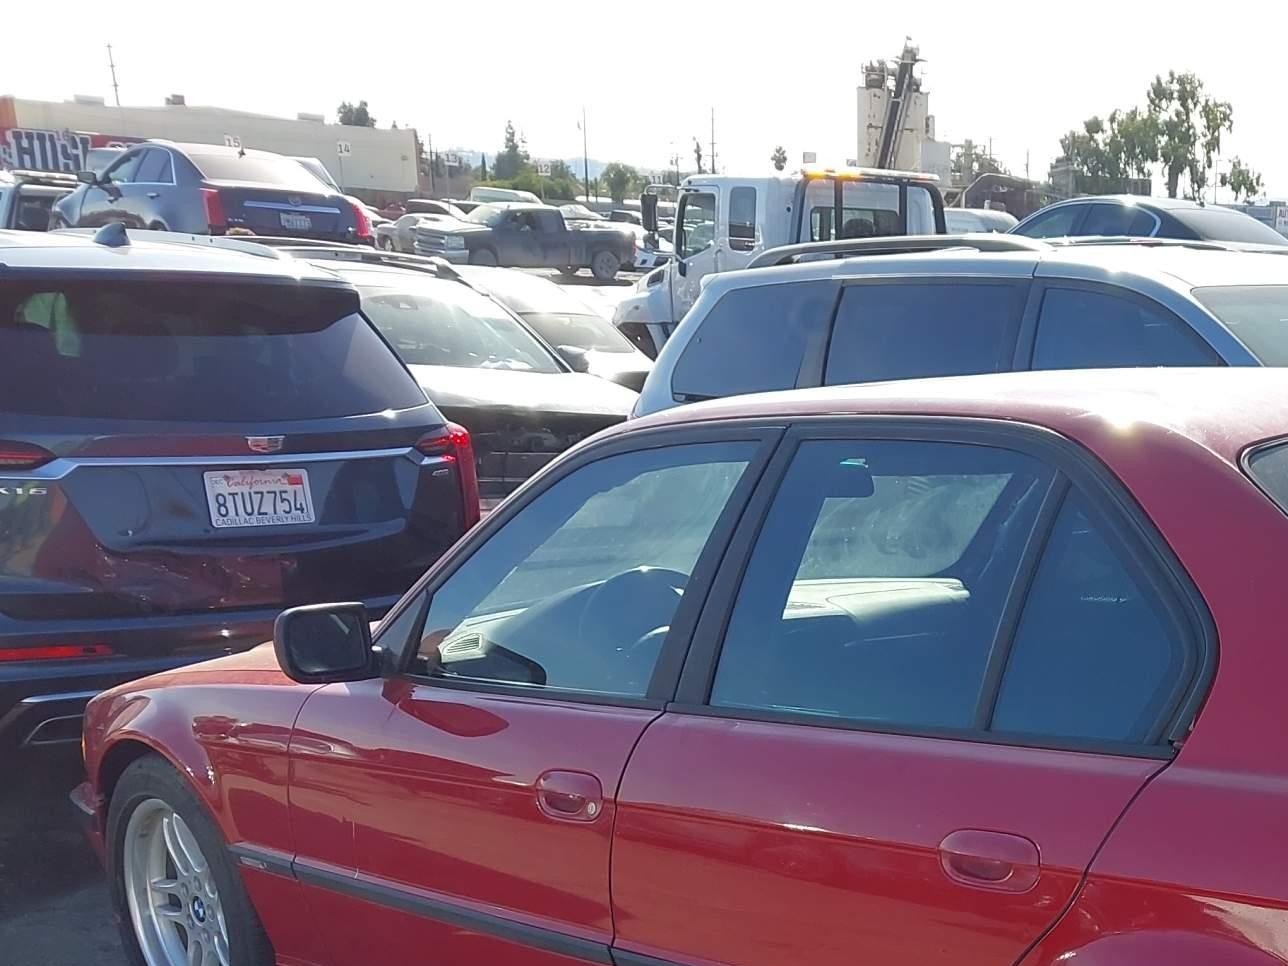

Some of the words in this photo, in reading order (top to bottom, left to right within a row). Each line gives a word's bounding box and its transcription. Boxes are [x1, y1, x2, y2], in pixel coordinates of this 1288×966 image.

[338, 143, 350, 153] 14
[539, 164, 550, 173] 12
[226, 476, 284, 489] California
[215, 489, 305, 518] 8TUZ754
[215, 517, 255, 527] CADILLAC
[256, 514, 290, 525] BEVERLY
[291, 513, 312, 522] HILLS
